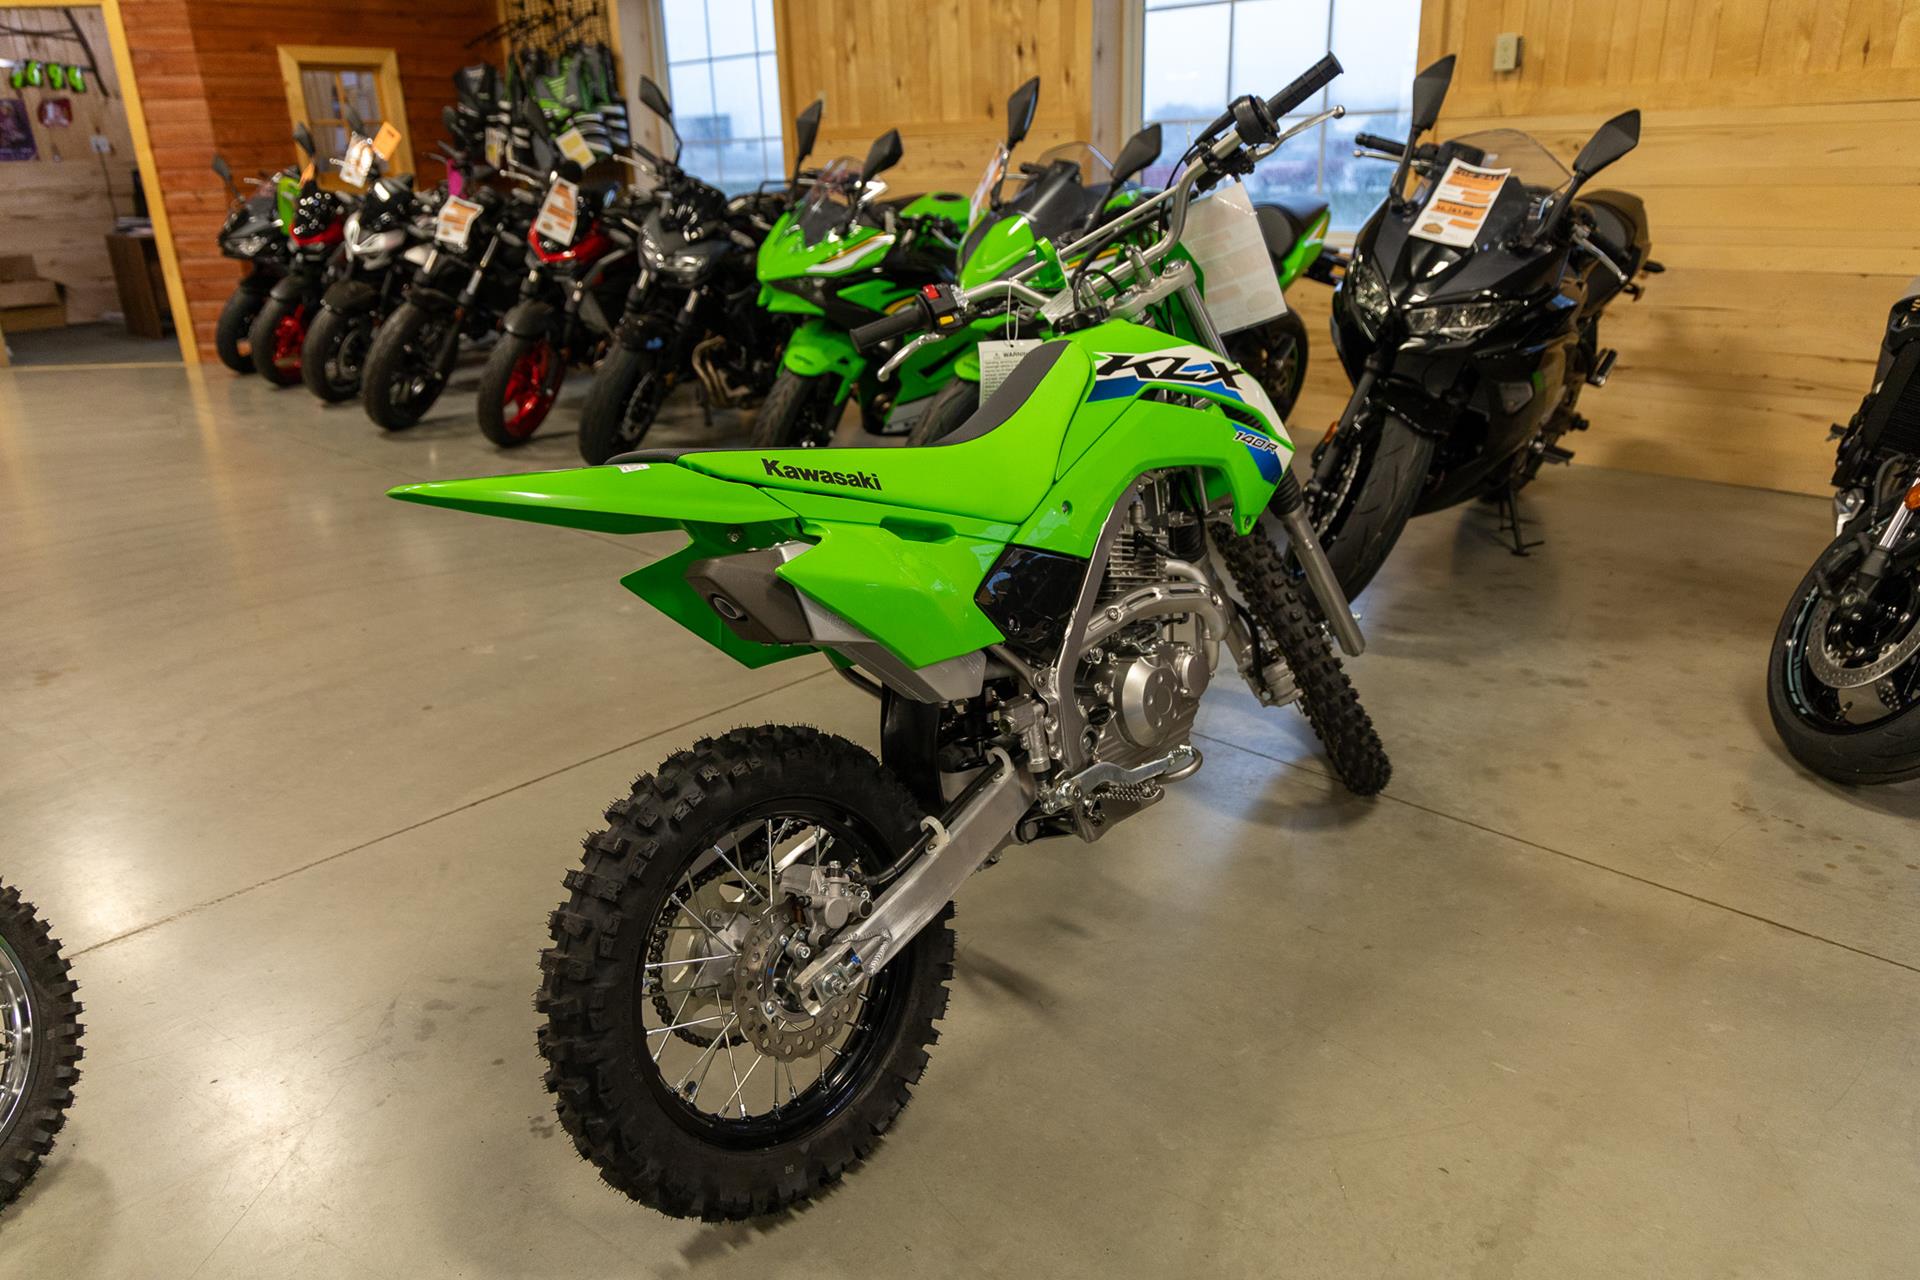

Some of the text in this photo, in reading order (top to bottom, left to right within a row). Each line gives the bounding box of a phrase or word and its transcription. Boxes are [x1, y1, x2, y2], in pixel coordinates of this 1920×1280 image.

[1096, 354, 1244, 390] KLX
[1234, 431, 1279, 453] 140R
[761, 458, 882, 490] Kawasaki
